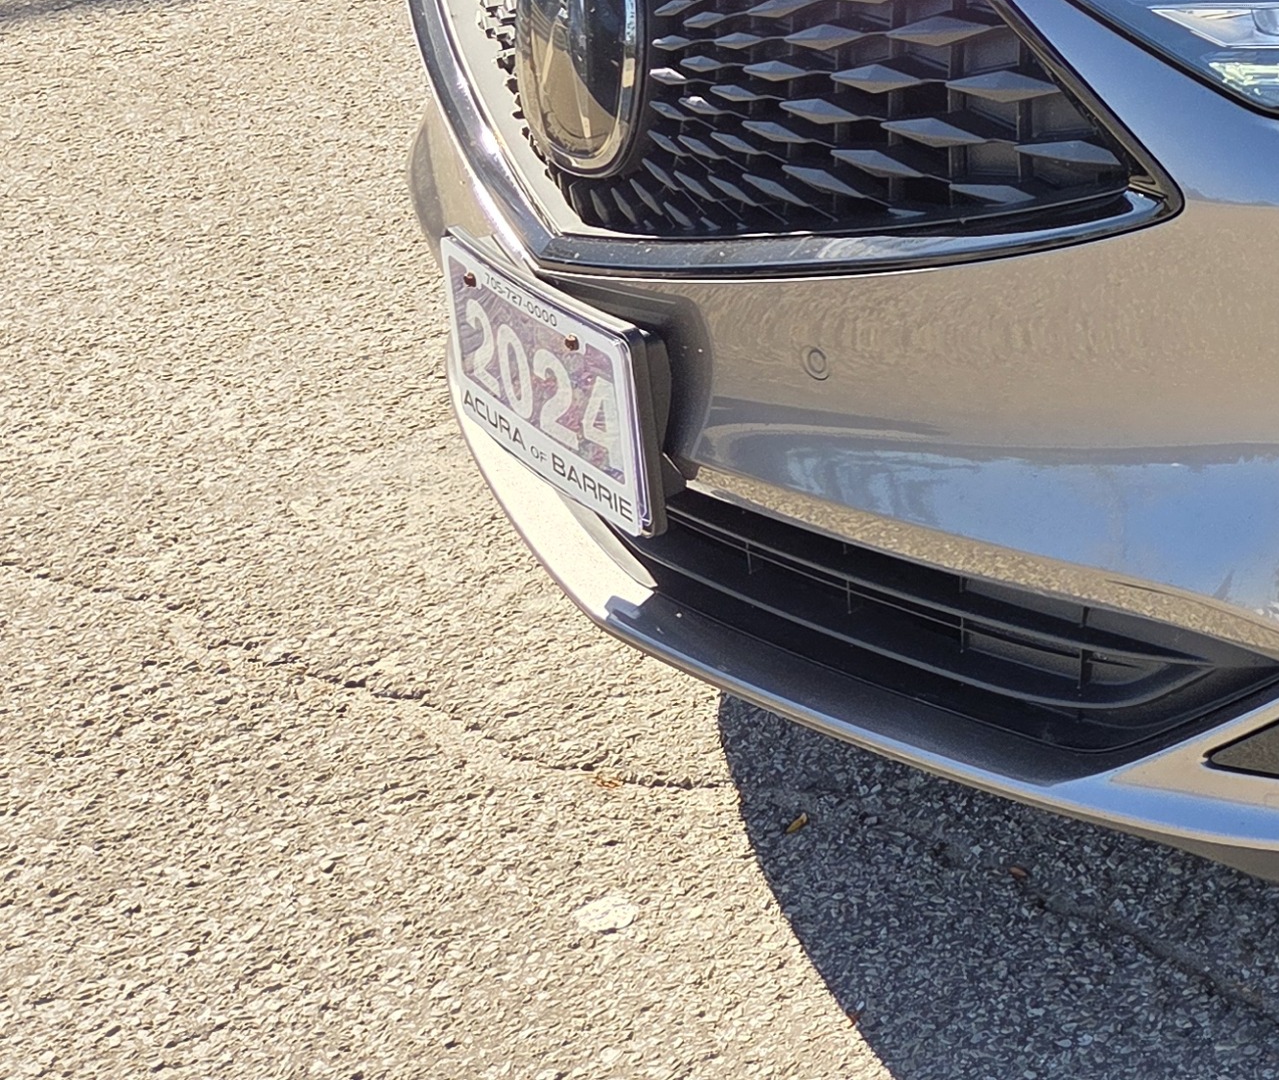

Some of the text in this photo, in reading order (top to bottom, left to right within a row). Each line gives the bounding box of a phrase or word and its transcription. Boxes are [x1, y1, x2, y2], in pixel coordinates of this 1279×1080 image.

[463, 390, 633, 523] ACURA OF BARRIE
[465, 298, 622, 468] 2024
